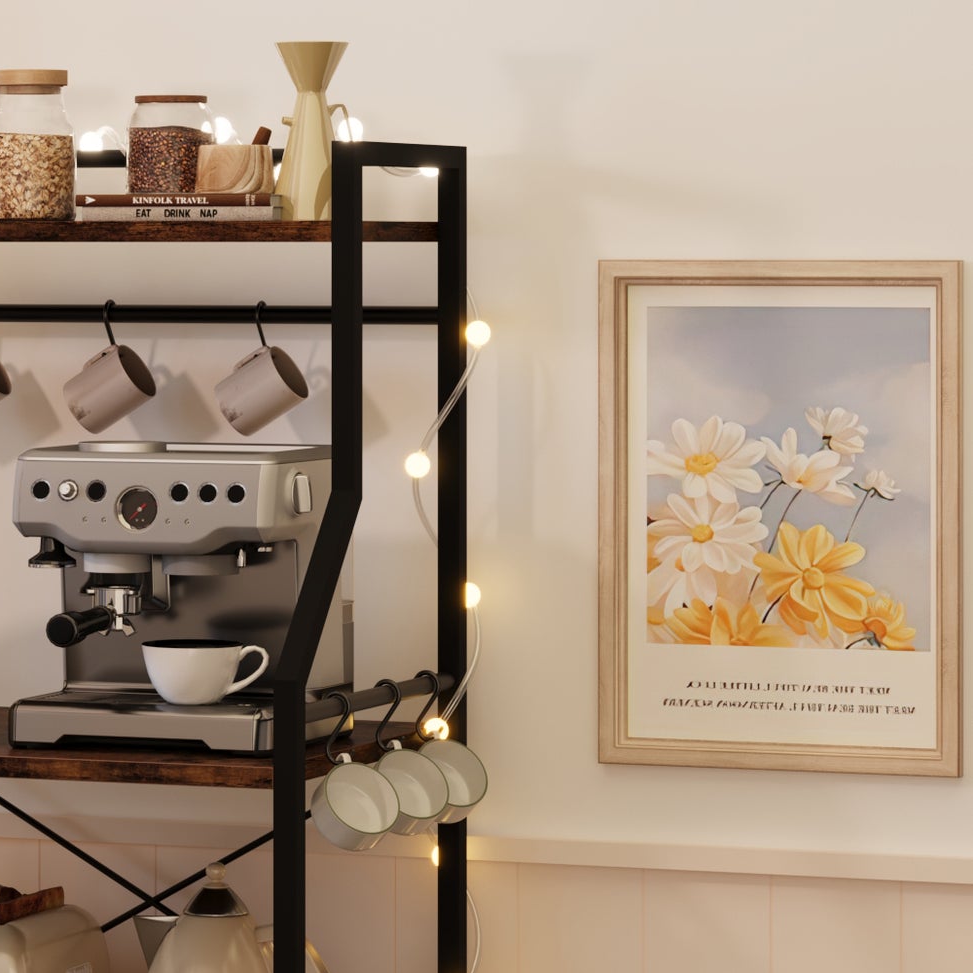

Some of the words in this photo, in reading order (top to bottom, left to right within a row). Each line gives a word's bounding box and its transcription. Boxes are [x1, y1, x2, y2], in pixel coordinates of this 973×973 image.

[132, 196, 173, 205] KINFOLK
[175, 197, 209, 205] TRAVEL
[136, 208, 151, 218] EAT
[164, 208, 191, 218] DRINK
[200, 209, 218, 218] NAP
